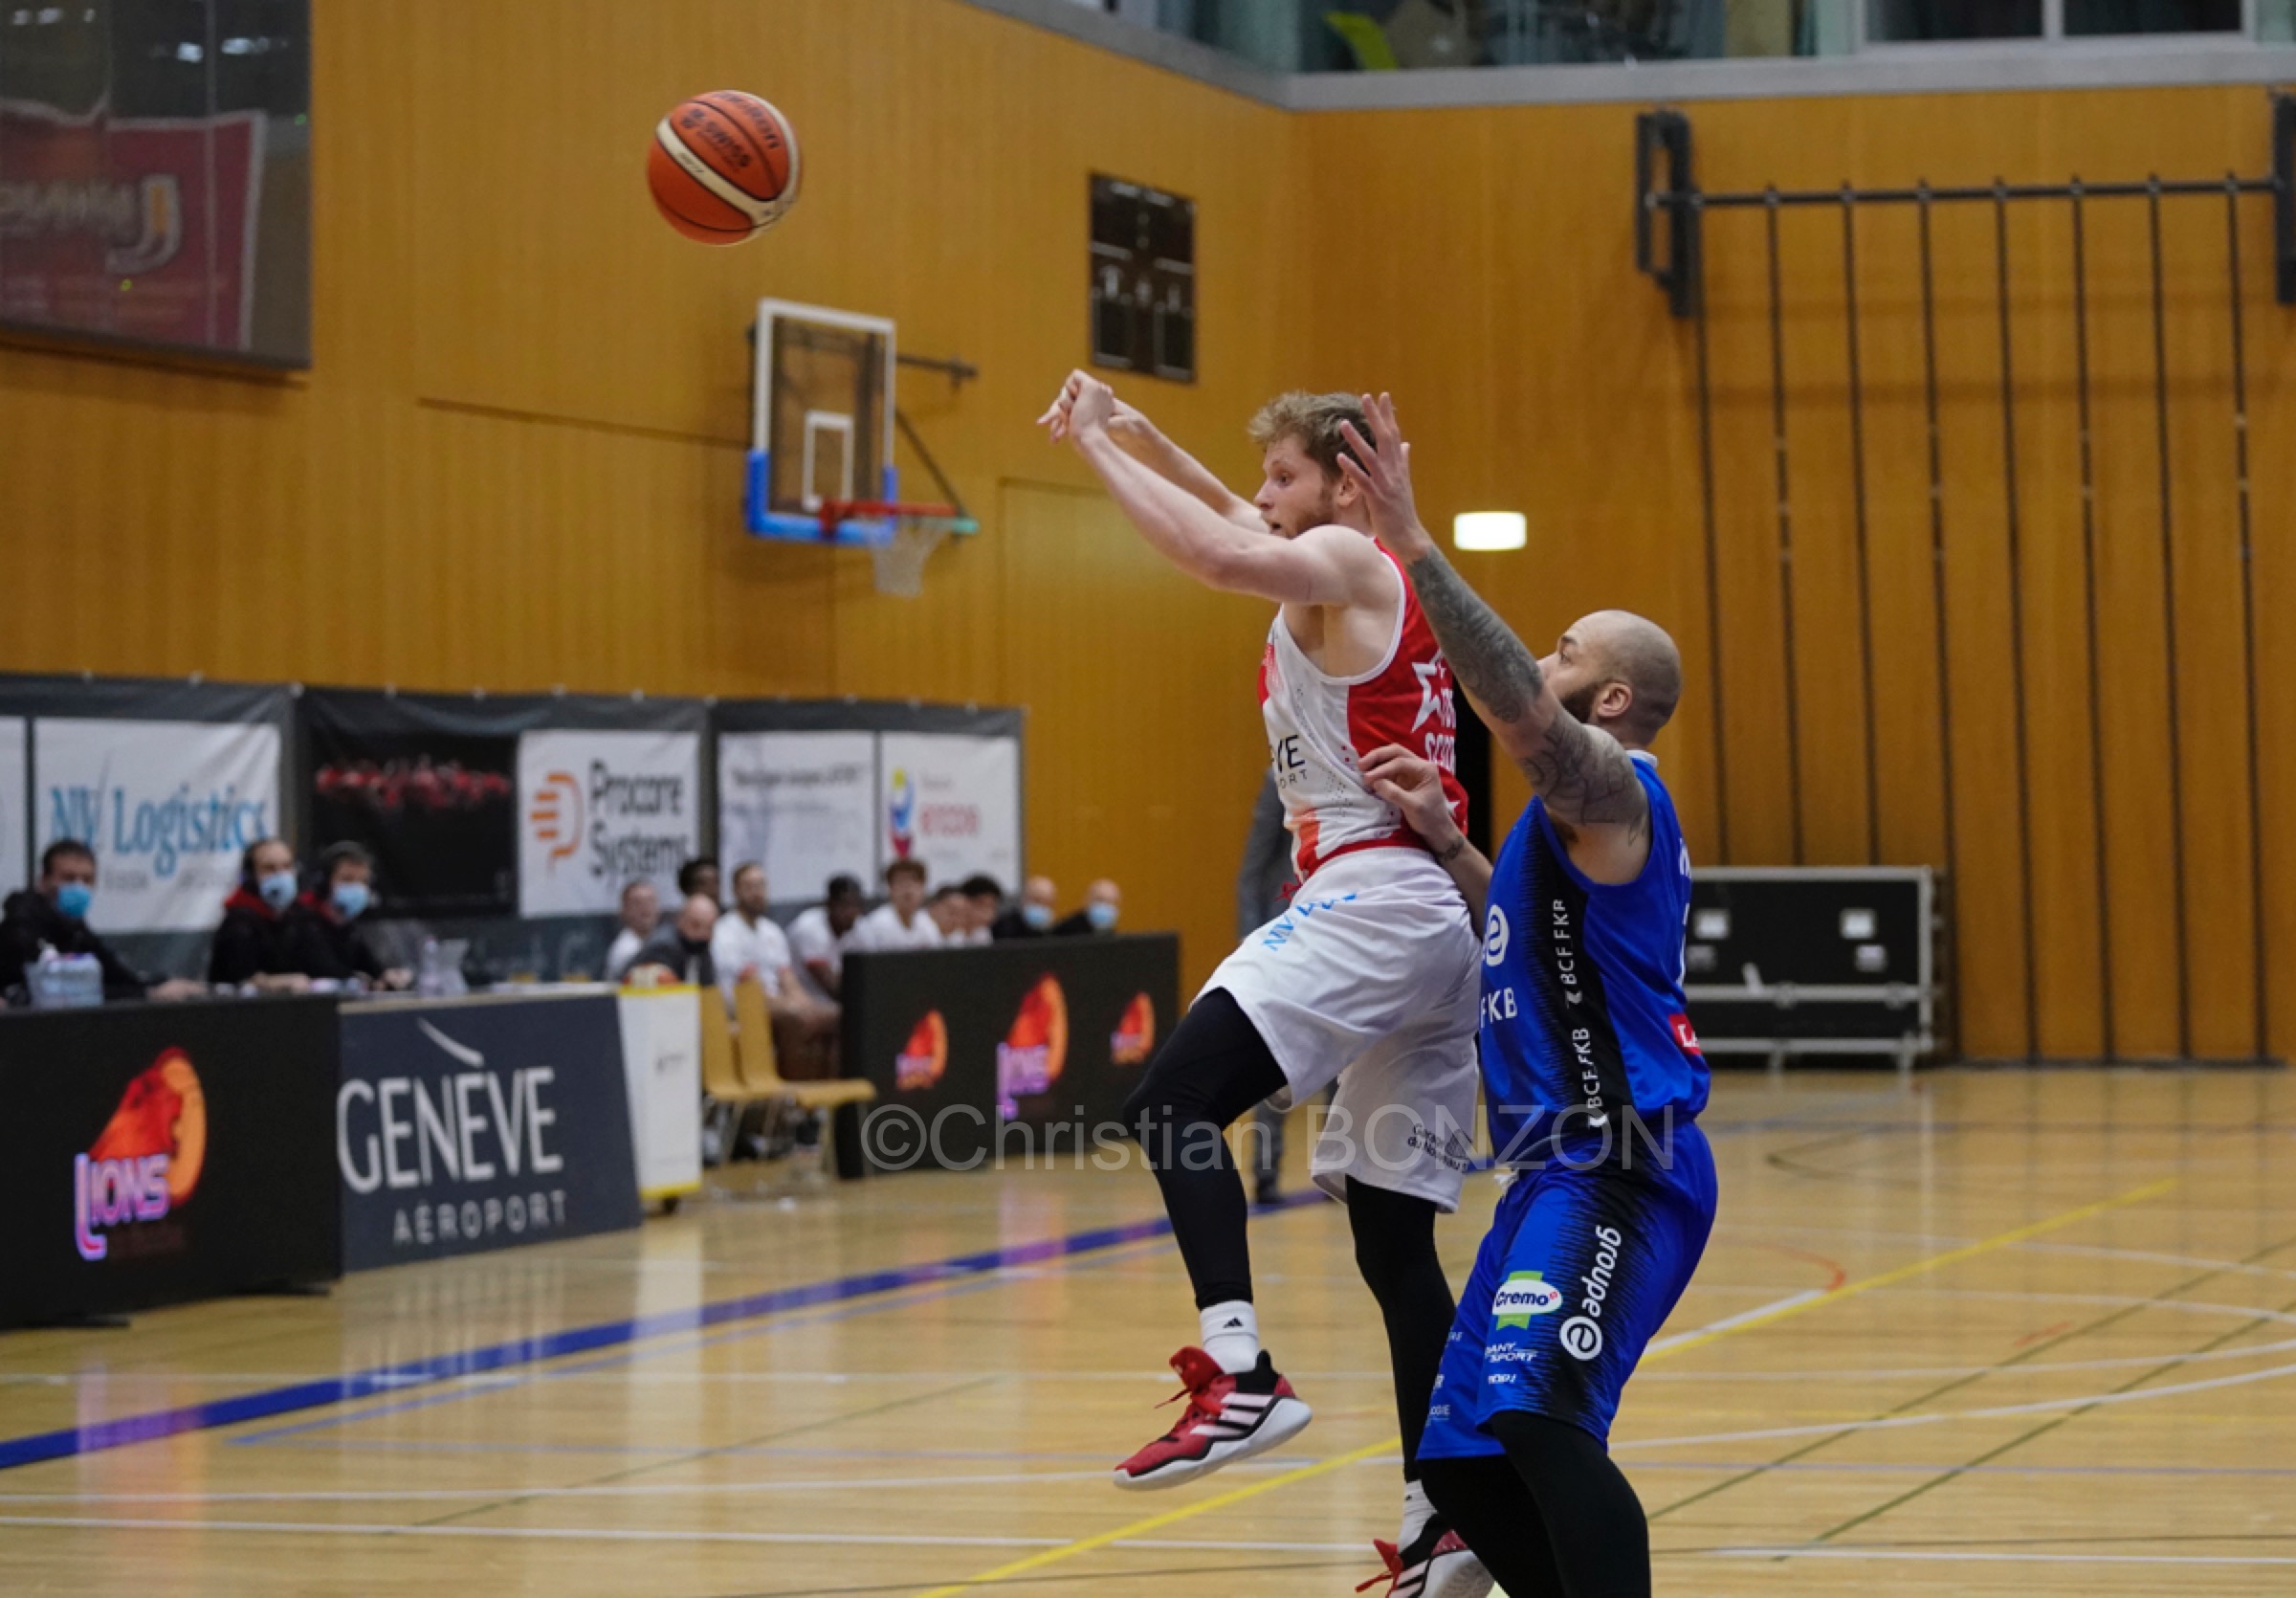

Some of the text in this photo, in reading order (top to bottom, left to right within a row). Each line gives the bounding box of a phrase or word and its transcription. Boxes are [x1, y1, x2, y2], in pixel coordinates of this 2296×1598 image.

[590, 759, 683, 817] Procare
[590, 819, 690, 888] Systems
[337, 1016, 564, 1194] GENÈVE
[1494, 1291, 1550, 1307] Cremo
[1580, 1224, 1623, 1318] groupe
